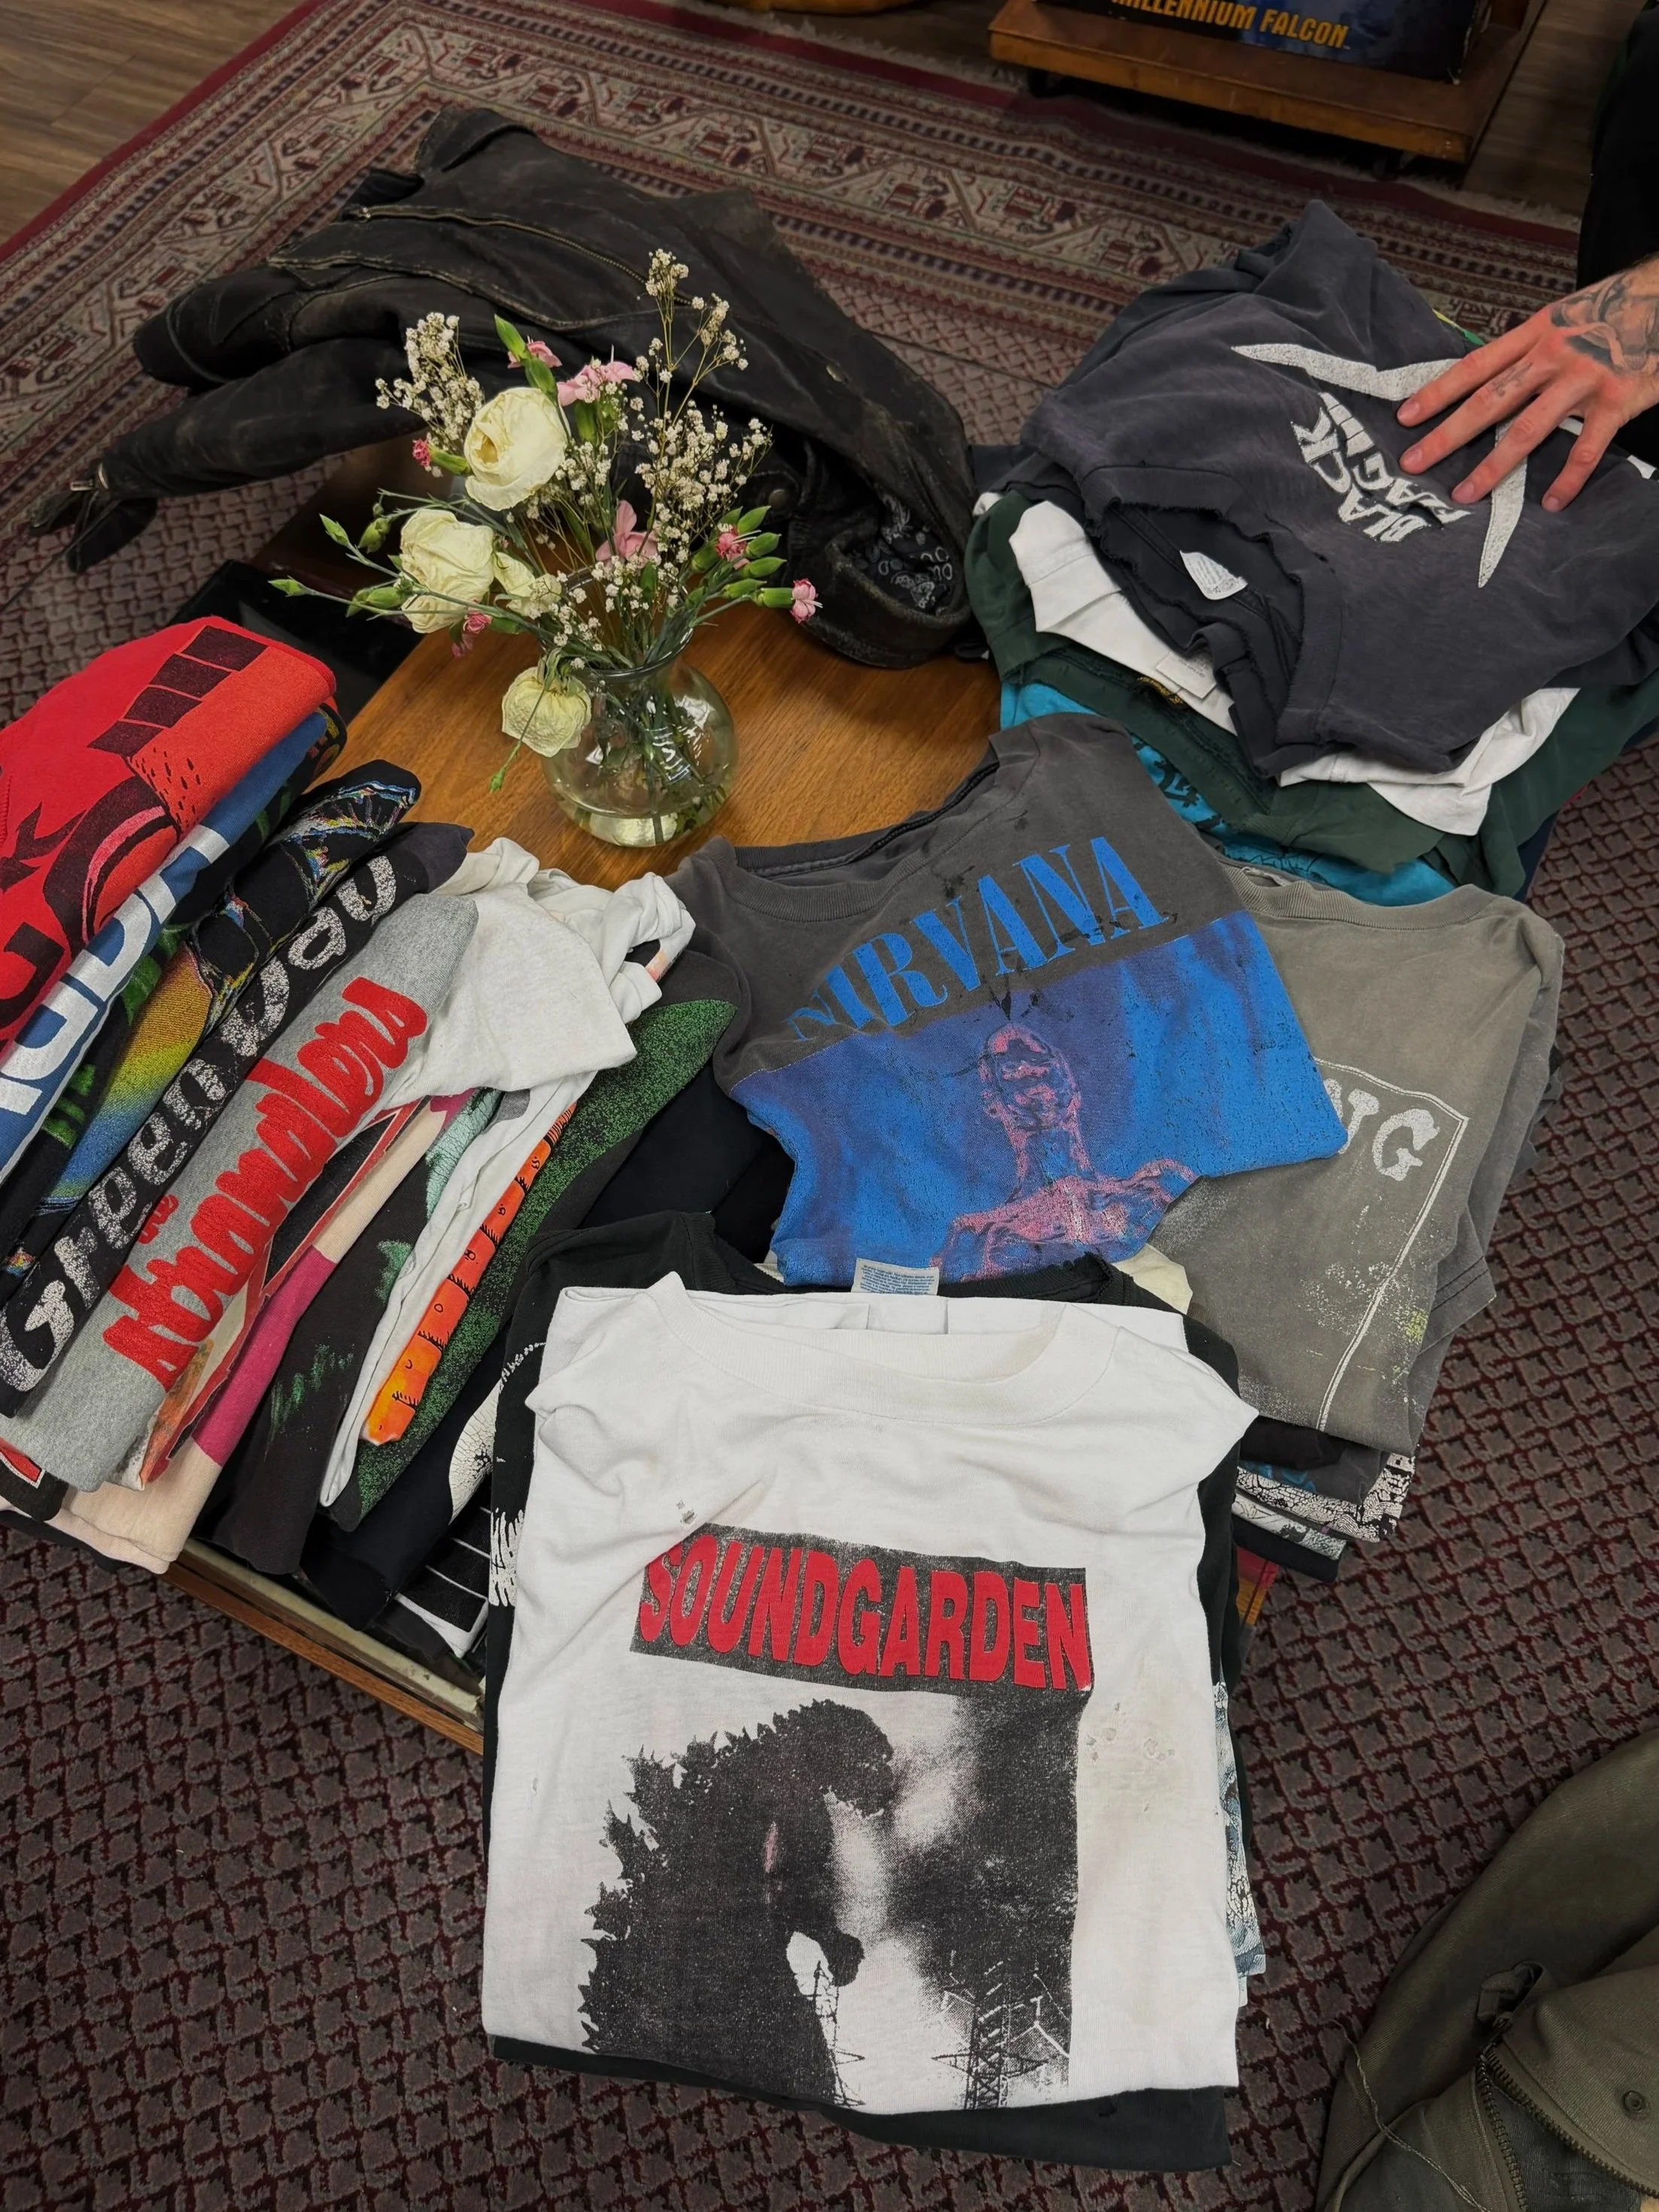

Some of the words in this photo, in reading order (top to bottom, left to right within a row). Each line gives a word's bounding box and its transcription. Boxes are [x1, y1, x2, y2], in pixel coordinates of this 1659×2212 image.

[1111, 0, 1259, 30] LLENNIUM
[1259, 8, 1350, 48] FALCON
[1290, 407, 1432, 542] BLACK
[1352, 451, 1474, 524] FLAG
[782, 836, 1169, 1041] NIRVANA
[0, 1058, 230, 1392] Green
[221, 855, 397, 1058] Day
[640, 1534, 1092, 1691] SOUNDGARDEN
